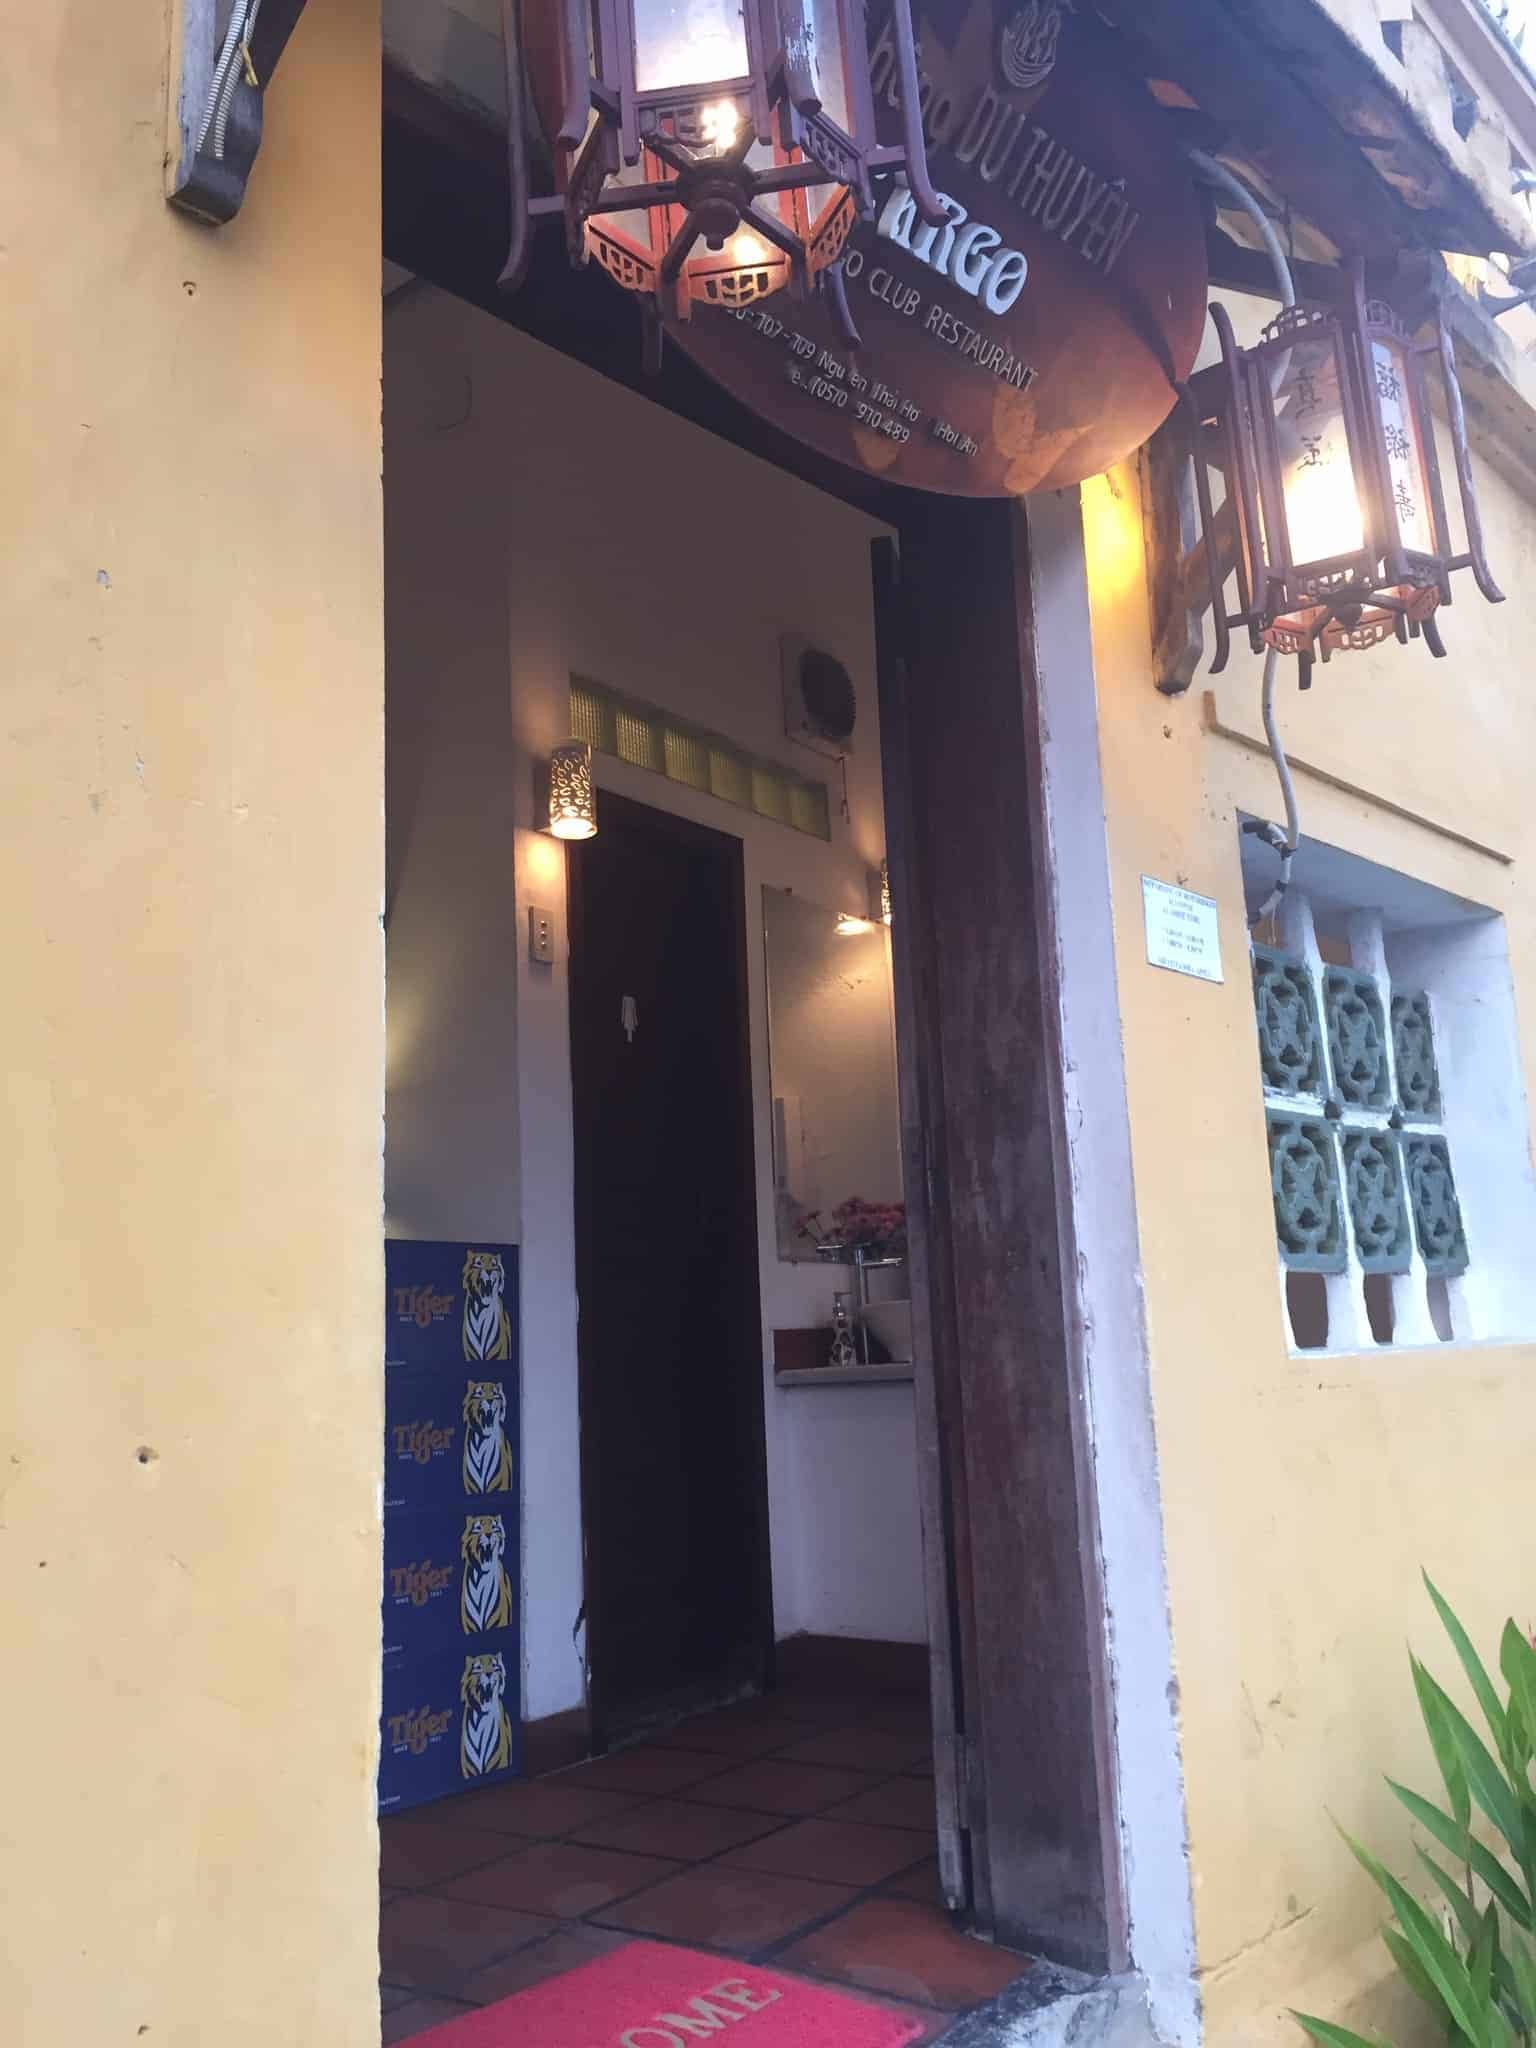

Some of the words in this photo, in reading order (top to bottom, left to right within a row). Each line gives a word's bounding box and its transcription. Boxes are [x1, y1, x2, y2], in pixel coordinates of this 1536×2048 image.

[873, 172, 1029, 316] ARGO
[868, 267, 922, 317] CLUB
[924, 304, 1039, 394] RESTAURANT
[883, 419, 912, 445] 489
[393, 1284, 455, 1328] Tiger
[393, 1419, 455, 1465] Tiger
[389, 1559, 454, 1607] Tiger
[387, 1704, 453, 1755] Tiger
